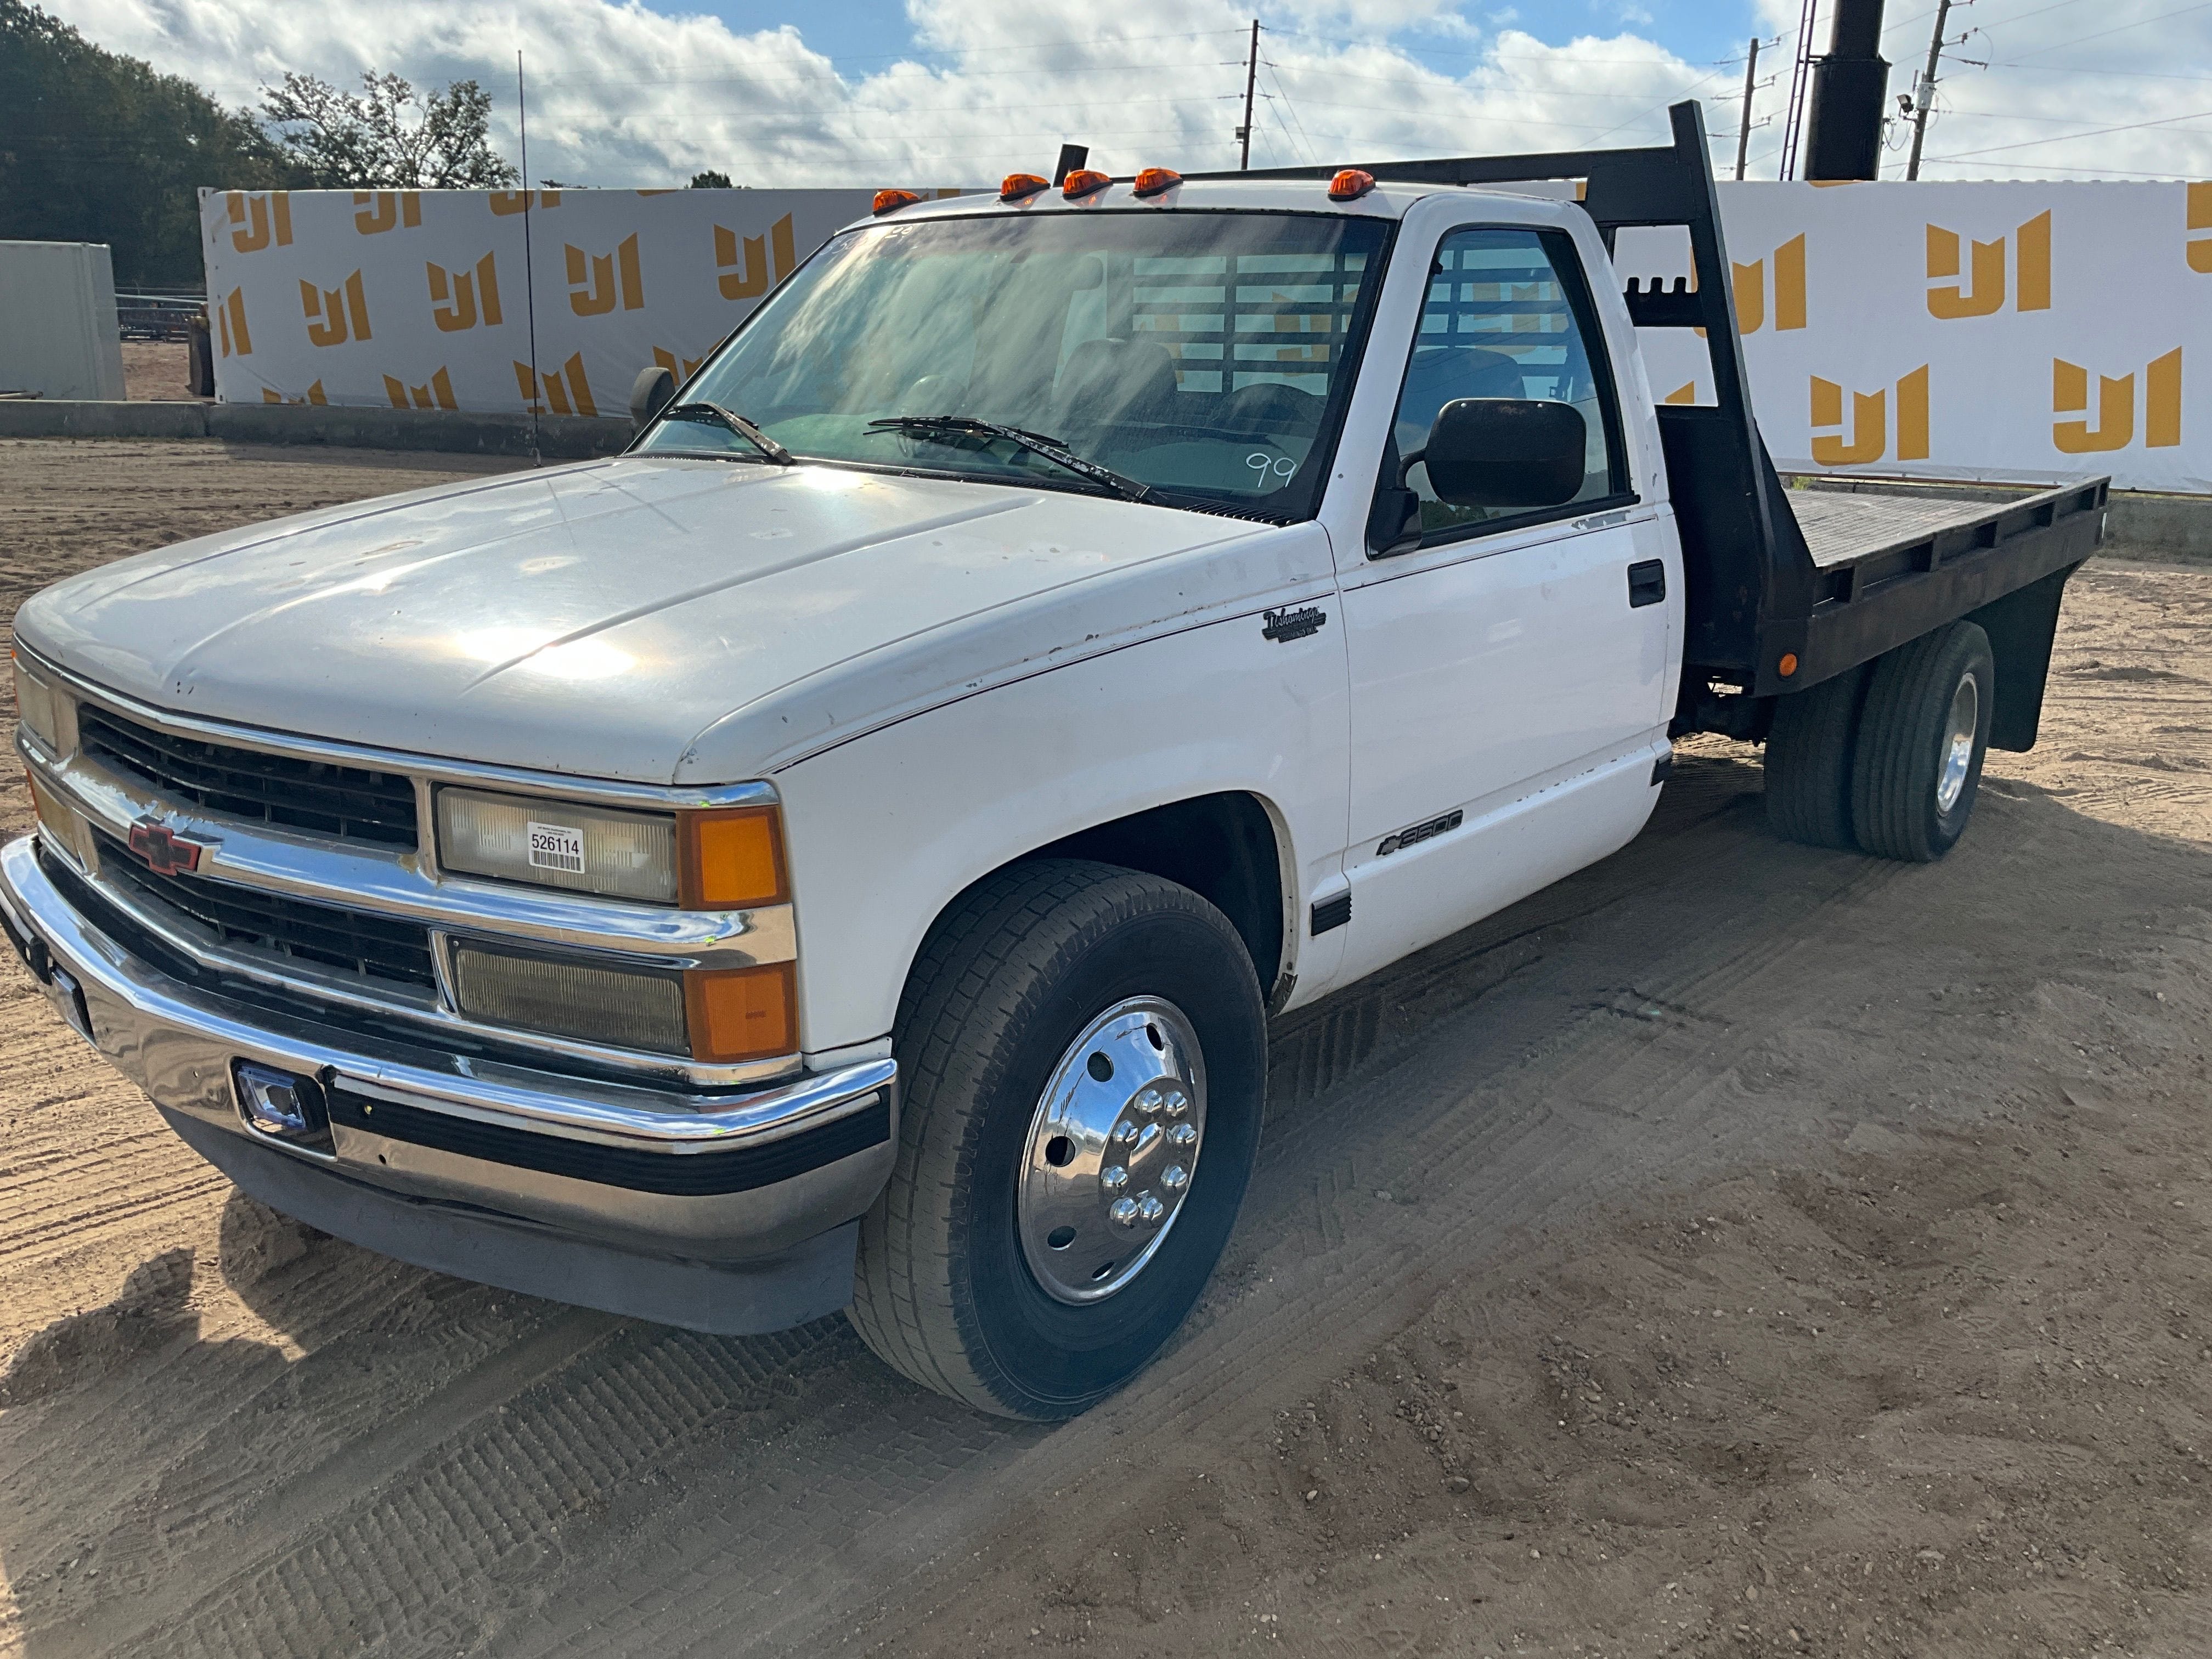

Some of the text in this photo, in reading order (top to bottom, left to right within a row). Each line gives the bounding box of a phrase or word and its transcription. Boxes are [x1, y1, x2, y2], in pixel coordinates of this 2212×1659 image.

[1246, 453, 1297, 488] 99
[532, 834, 579, 854] 526114
[1401, 810, 1463, 848] 3500
